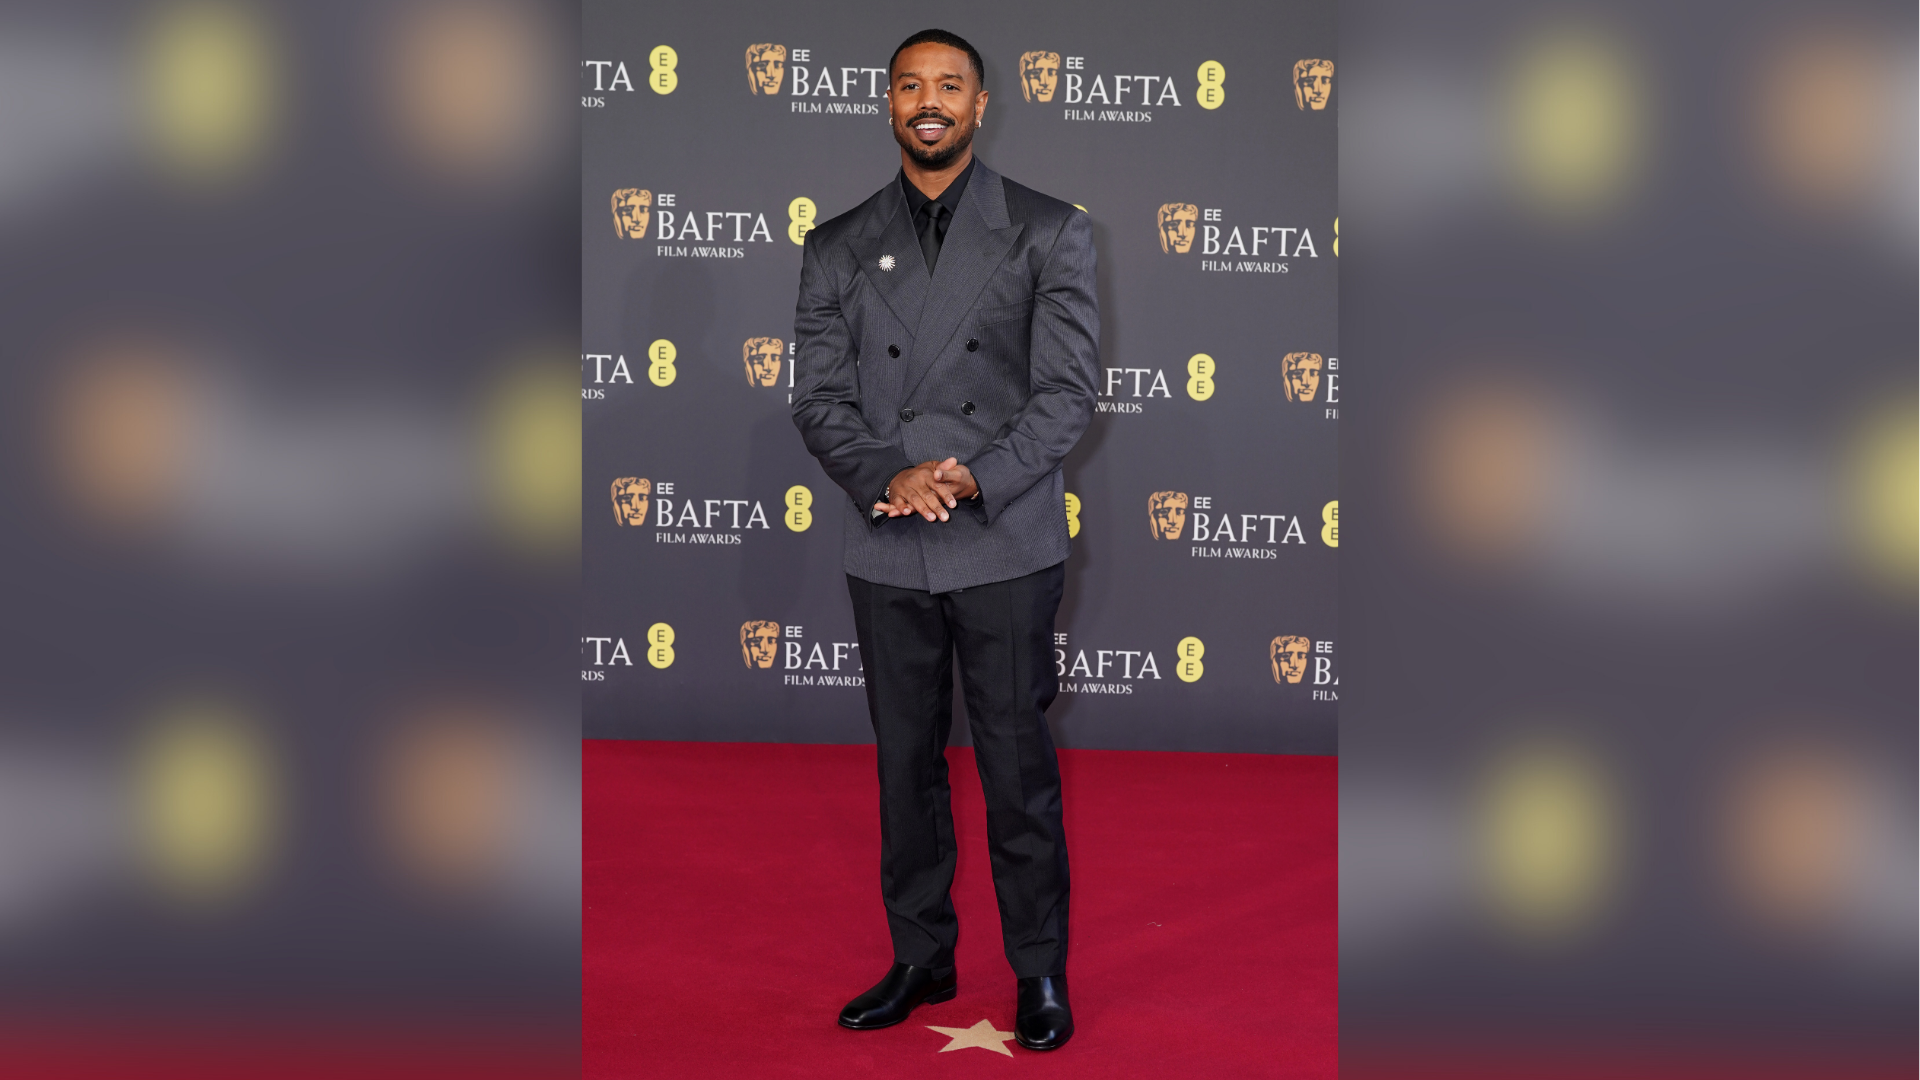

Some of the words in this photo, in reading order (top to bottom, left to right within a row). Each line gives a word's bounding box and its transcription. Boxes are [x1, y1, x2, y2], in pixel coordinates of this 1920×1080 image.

[793, 49, 810, 62] EE
[1066, 57, 1084, 69] EE
[582, 61, 634, 91] TA
[792, 66, 890, 98] BAFT
[1065, 74, 1181, 106] BAFTA
[792, 102, 821, 113] FILM
[826, 103, 878, 114] AWARDS
[1065, 110, 1094, 120] FILM
[1098, 111, 1151, 122] AWARDS
[658, 194, 675, 206] EE
[1204, 209, 1222, 221] EE
[657, 211, 773, 242] BAFTA
[1202, 225, 1318, 257] BAFTA
[658, 246, 687, 257] FILM
[691, 247, 744, 258] AWARDS
[1202, 260, 1231, 271] FILM
[1236, 262, 1288, 273] AWARDS
[582, 354, 634, 384] TA
[1098, 368, 1172, 398] FTA
[657, 483, 674, 494] EE
[1194, 497, 1211, 509] EE
[656, 499, 770, 529] BAFTA
[1192, 513, 1306, 544] BAFTA
[656, 533, 685, 543] FILM
[689, 534, 741, 544] AWARDS
[1192, 547, 1221, 557] FILM
[1225, 548, 1277, 559] AWARDS
[786, 626, 803, 637] EE
[582, 637, 633, 666] TA
[1316, 641, 1333, 653] EE
[785, 642, 863, 671] BAF
[785, 675, 813, 685] FILM
[1060, 683, 1077, 692] LM
[1081, 683, 1132, 694] AWARDS
